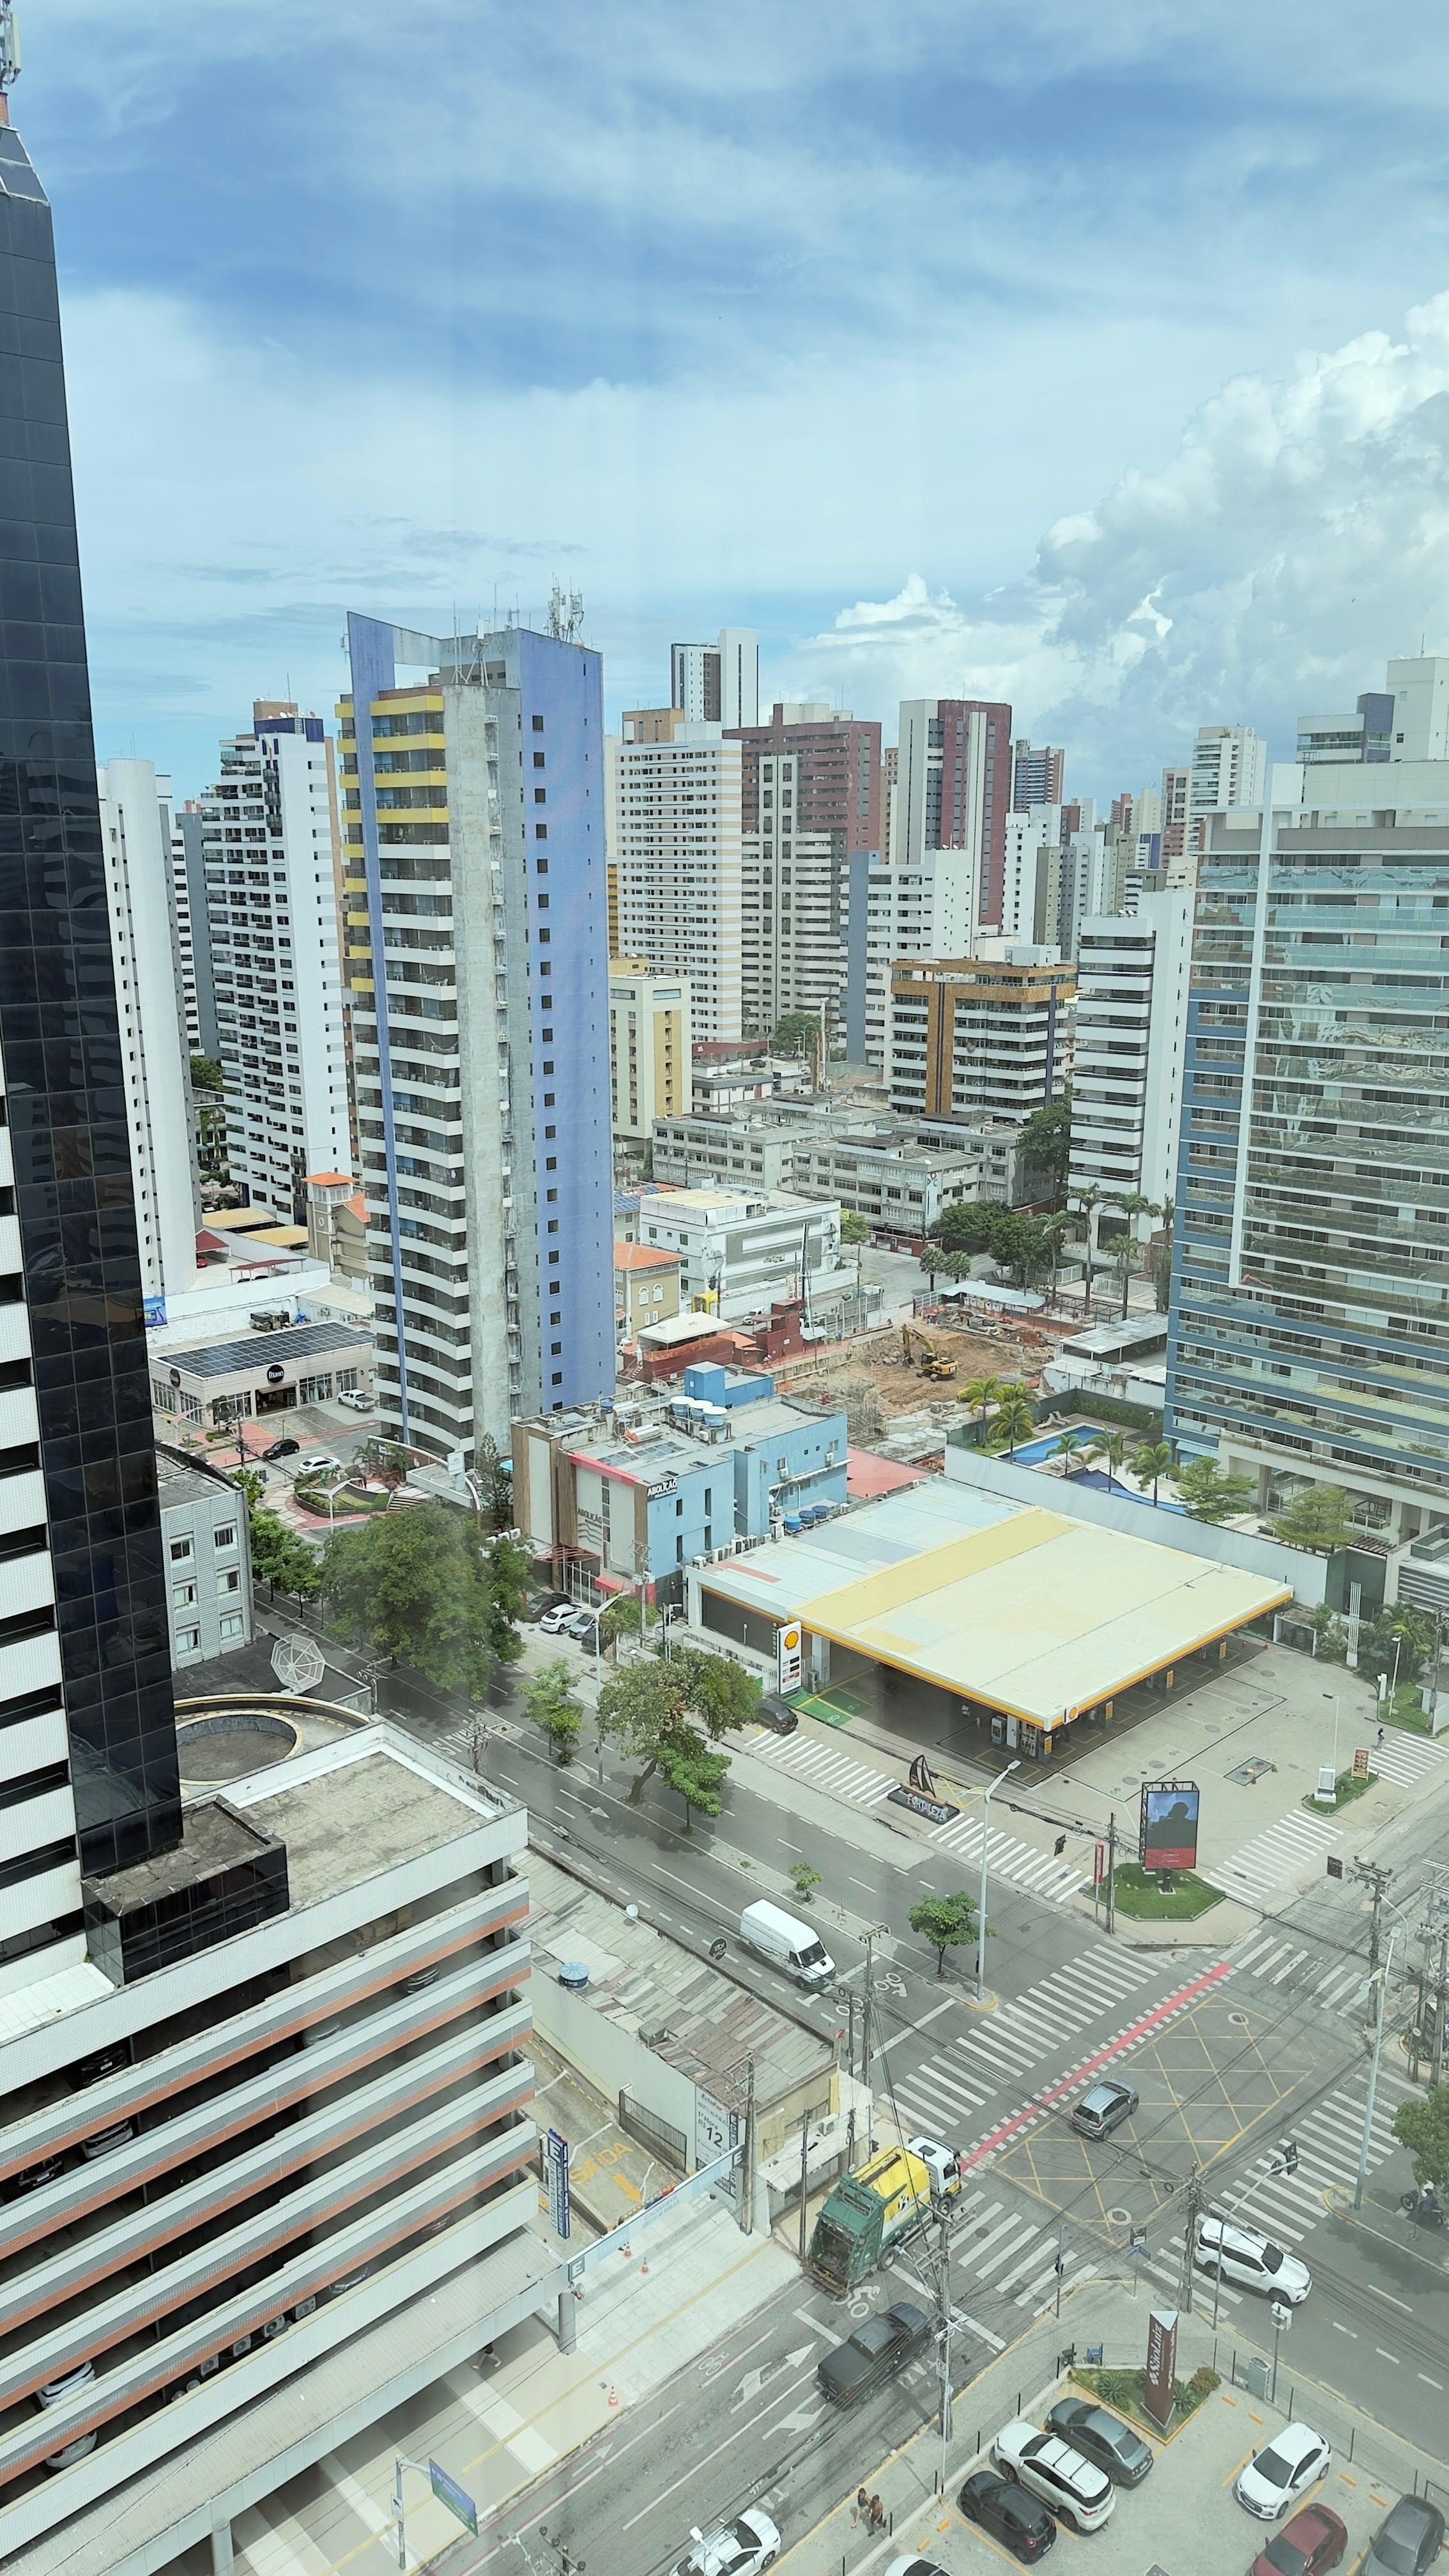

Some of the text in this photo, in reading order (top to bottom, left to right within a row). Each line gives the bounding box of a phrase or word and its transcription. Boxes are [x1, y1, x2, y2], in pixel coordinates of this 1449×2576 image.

[647, 1478, 677, 1496] ABOLIÇÃO
[907, 1793, 949, 1820] FORTALEZA
[707, 2127, 723, 2149] 12
[549, 2142, 561, 2163] E
[734, 2149, 743, 2166] E
[569, 2142, 634, 2185] SAÍDA
[549, 2159, 557, 2229] ESTACIONAMENTO
[572, 2259, 583, 2278] E
